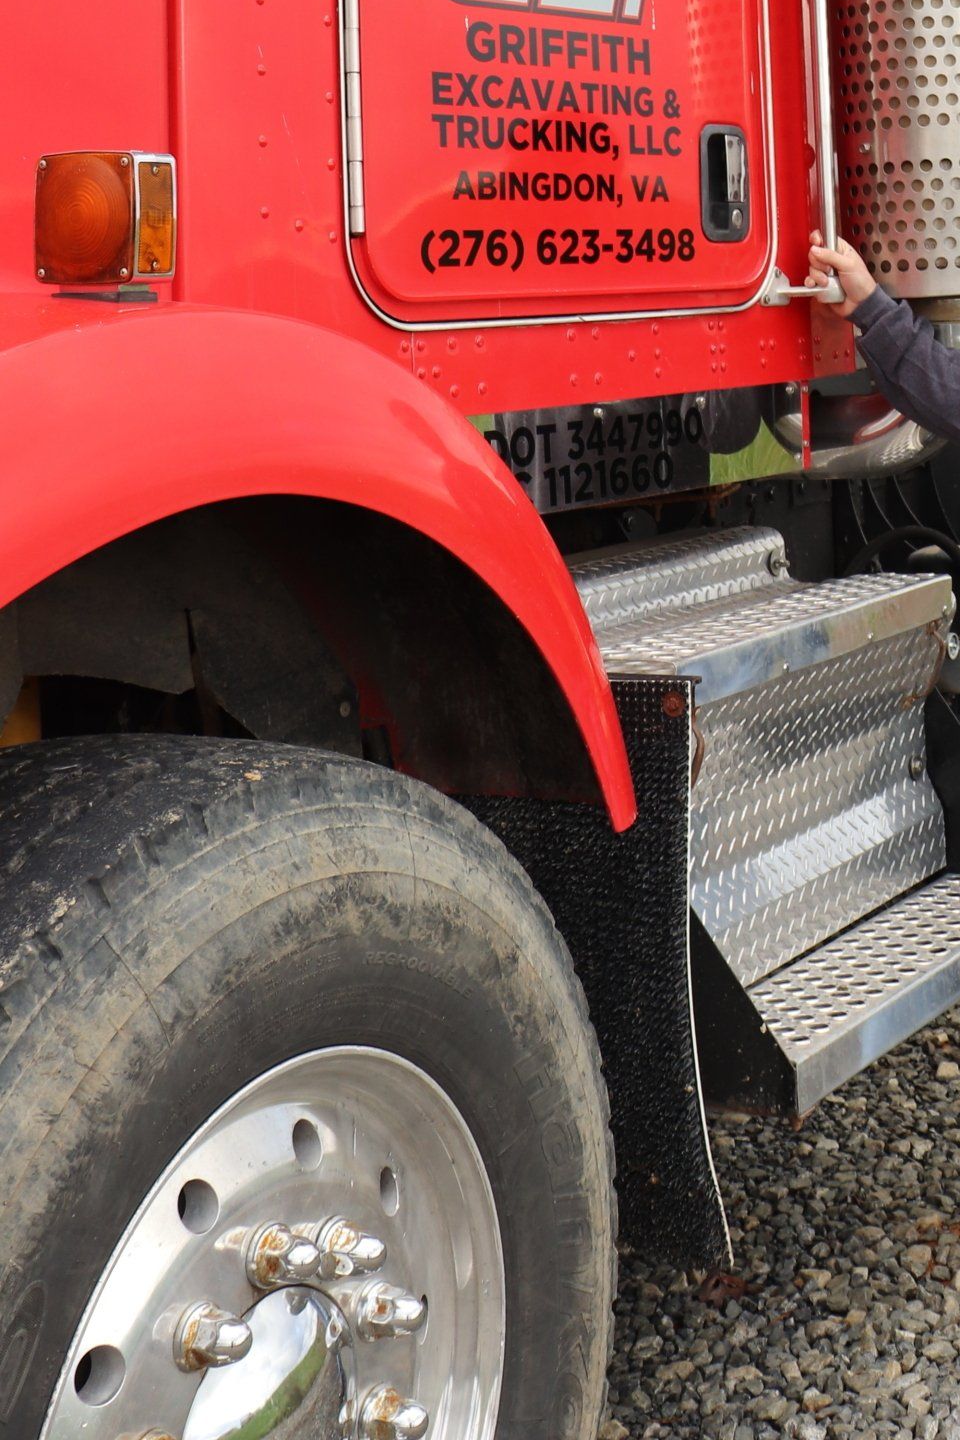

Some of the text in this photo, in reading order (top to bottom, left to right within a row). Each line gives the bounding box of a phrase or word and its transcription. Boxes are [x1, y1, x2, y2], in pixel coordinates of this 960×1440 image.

[465, 21, 652, 75] GRIFFITH
[431, 71, 682, 119] EXCAVATING &
[432, 114, 683, 161] TRUCKING, LLC
[453, 170, 670, 208] ABINGDON, VA
[420, 228, 696, 274] (276) 623-3498
[567, 407, 703, 460] 3447990
[544, 451, 675, 507] 1121660
